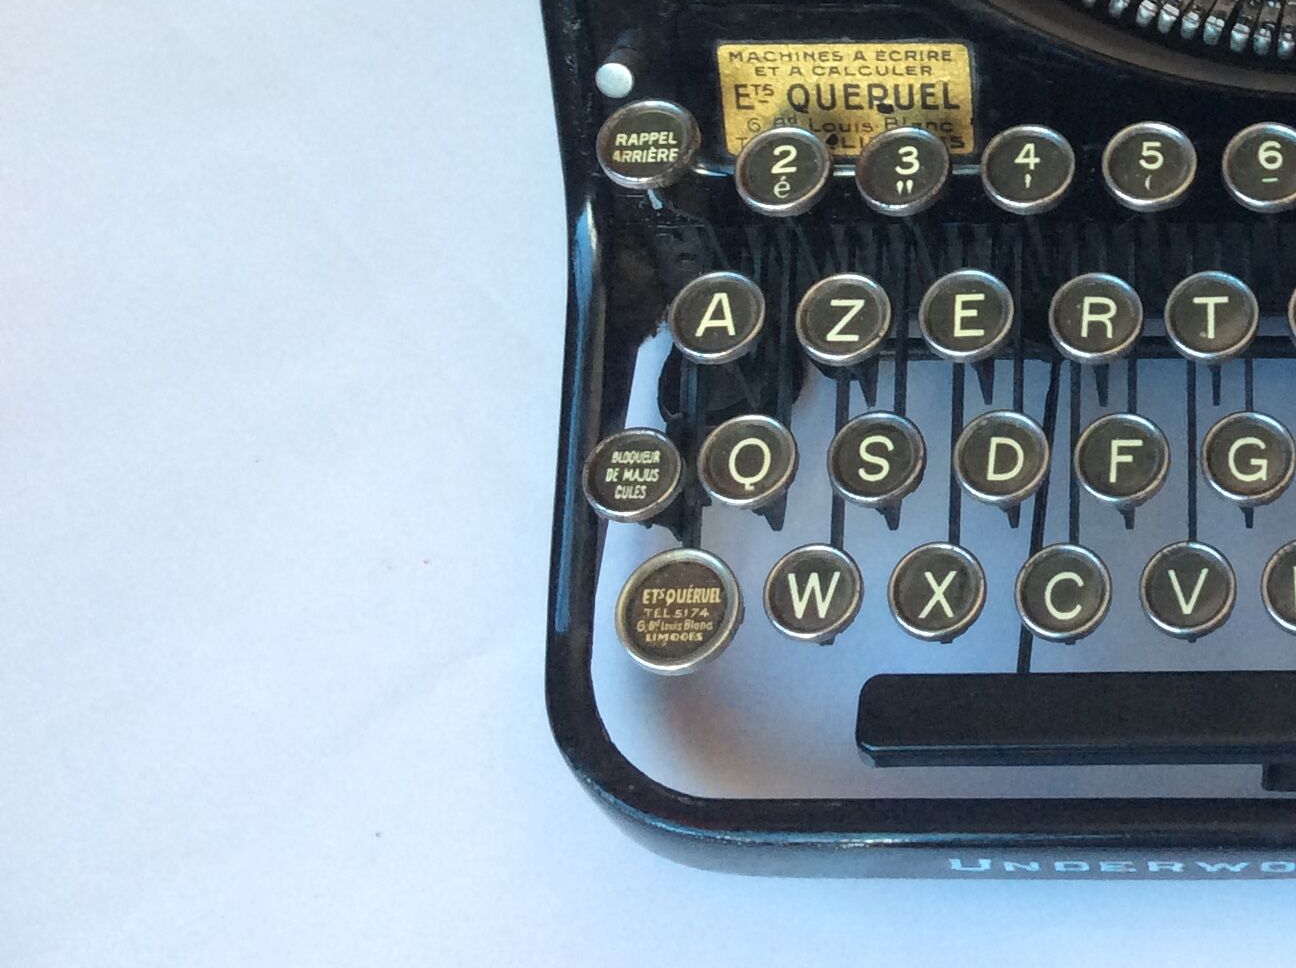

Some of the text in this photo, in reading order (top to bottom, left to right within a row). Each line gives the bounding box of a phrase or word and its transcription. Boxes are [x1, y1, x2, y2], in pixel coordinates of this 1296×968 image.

[729, 50, 843, 63] MACHINES
[754, 65, 778, 77] ET
[811, 65, 933, 78] CALCULER
[615, 131, 678, 146] RAPPEL
[771, 145, 798, 175] 2
[894, 145, 920, 175] 3
[1014, 142, 1040, 170] 4
[1139, 141, 1164, 170] 5
[1258, 140, 1283, 170] 6
[773, 176, 791, 198] é
[695, 293, 736, 337] A
[826, 298, 865, 342] Z
[954, 293, 985, 338] E
[1080, 296, 1117, 339] R
[1193, 296, 1229, 339] T
[605, 468, 660, 482] DE MAJUS
[611, 450, 660, 464] BLOQUEUR
[729, 437, 771, 491] Q
[858, 435, 895, 482] S
[986, 436, 1025, 481] D
[1109, 439, 1143, 483] F
[1227, 436, 1268, 482] G
[614, 485, 647, 499] CULES
[788, 571, 841, 620] W
[917, 570, 957, 619] X
[1044, 571, 1085, 621] C
[1168, 567, 1209, 615] V
